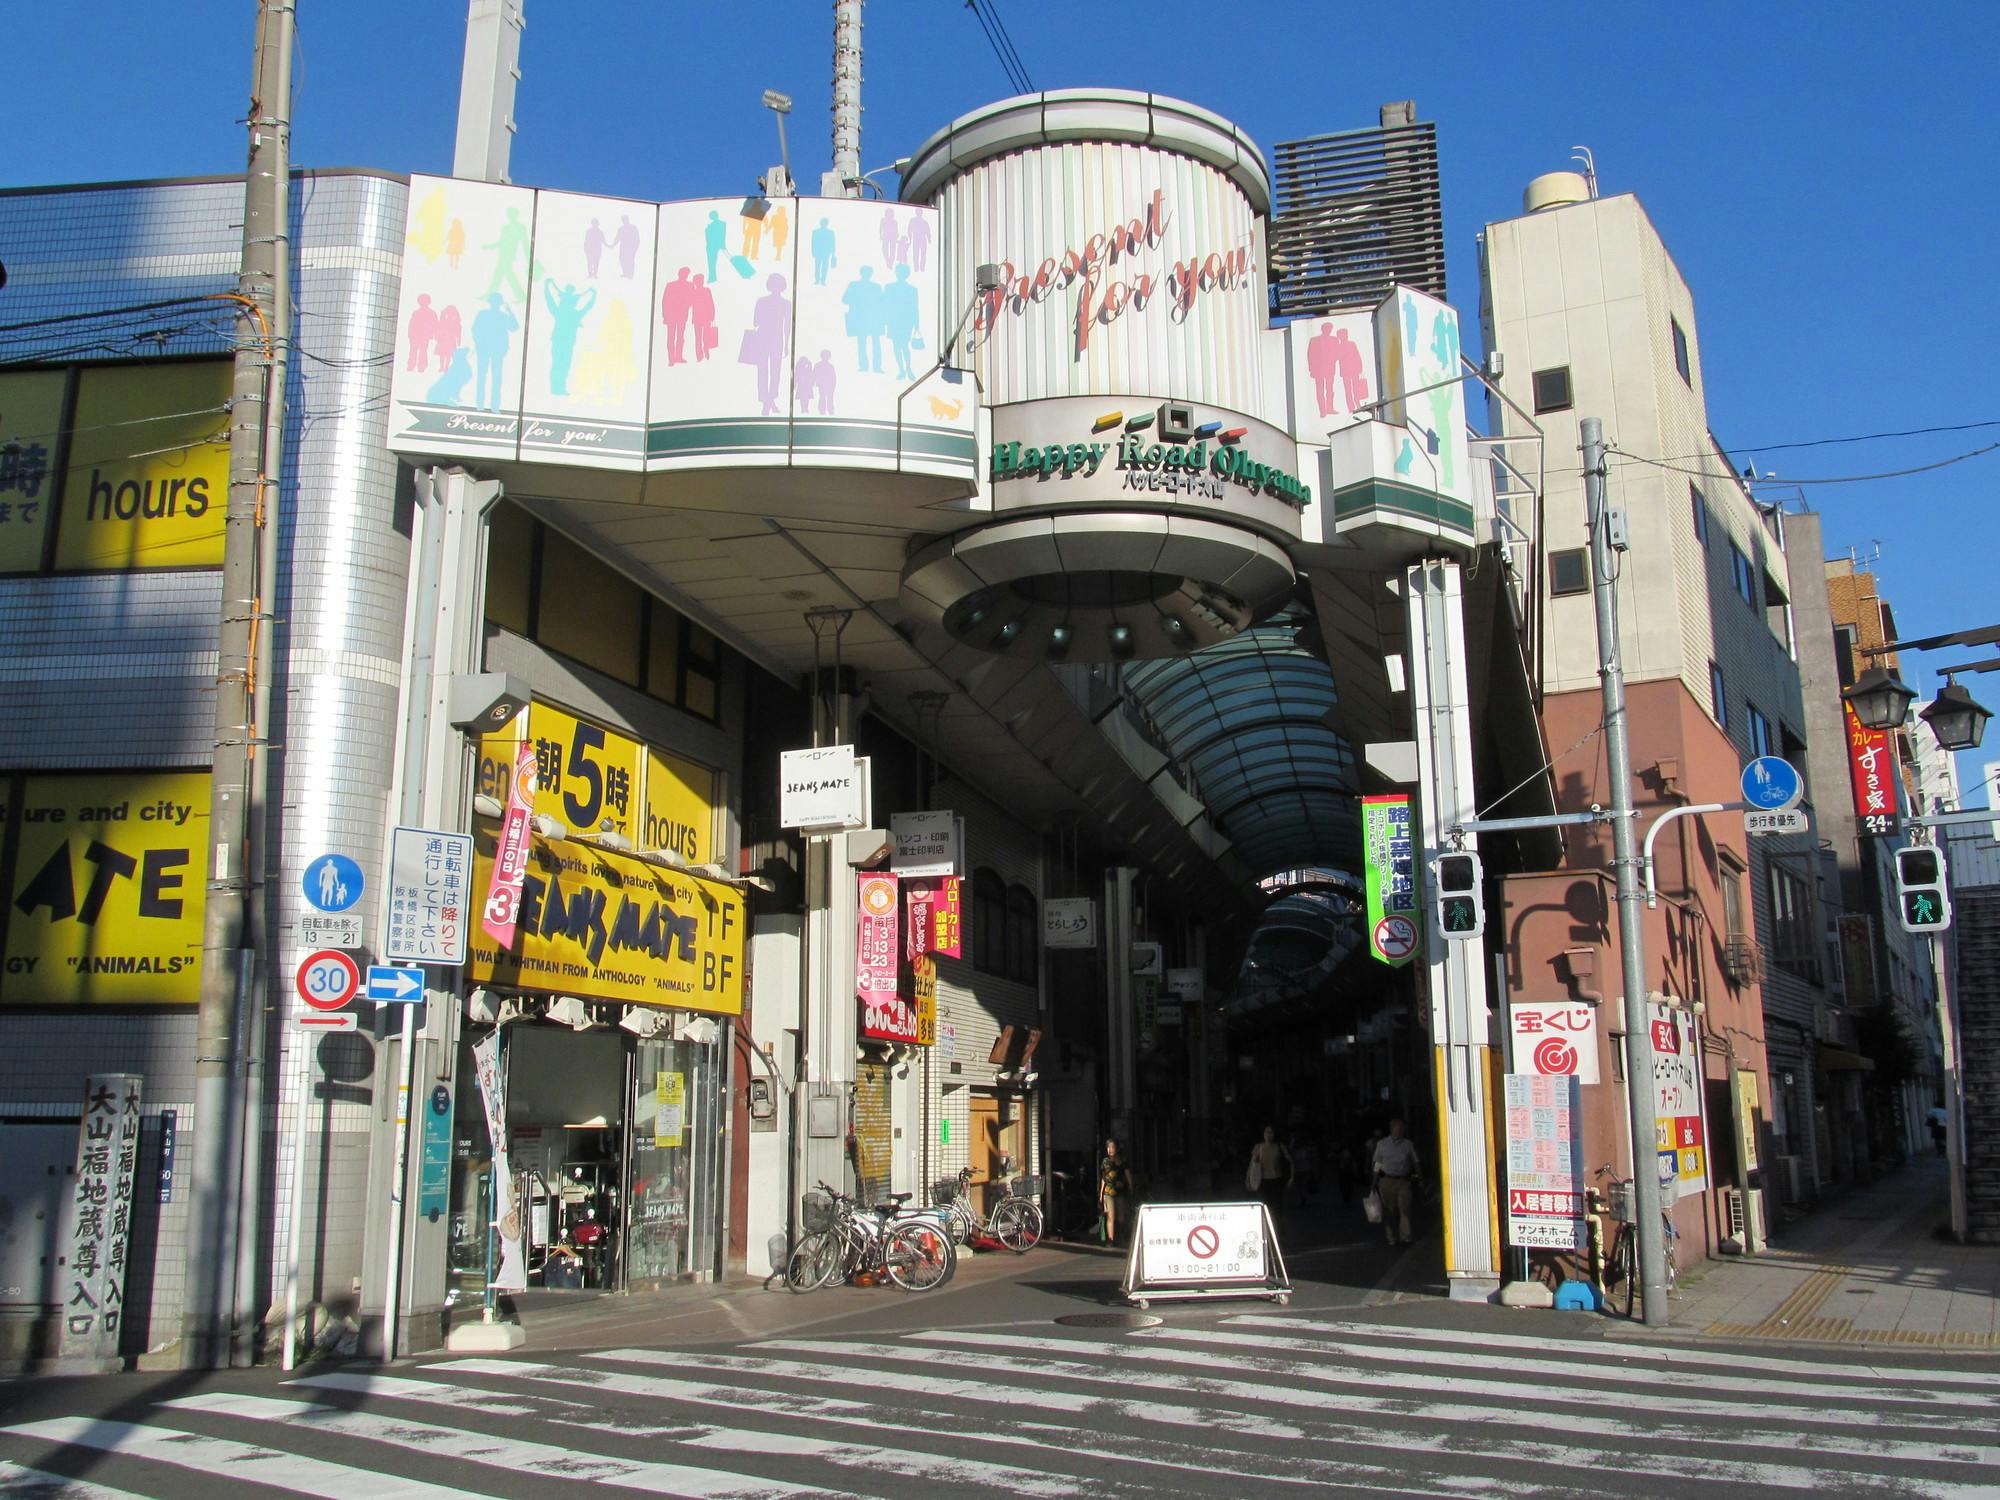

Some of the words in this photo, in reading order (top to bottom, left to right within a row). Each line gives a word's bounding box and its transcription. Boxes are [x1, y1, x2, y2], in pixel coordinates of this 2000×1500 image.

[1075, 262, 1161, 358] for
[1168, 230, 1257, 324] you!
[446, 414, 519, 434] Present
[521, 420, 554, 441] for
[561, 427, 608, 445] you!
[990, 440, 1111, 480] Happy
[1118, 432, 1207, 471] Road
[1218, 443, 1312, 505] Ohyama
[86, 469, 211, 521] hours
[1852, 731, 1884, 746] カレー
[535, 720, 630, 829] 朝5時
[786, 781, 818, 794] JEANS
[820, 778, 850, 791] MATE
[1857, 745, 1886, 814] すき家
[79, 802, 129, 821] and
[140, 801, 192, 826] city
[646, 801, 698, 860] hours
[1749, 814, 1796, 828] 歩行者優先
[418, 837, 443, 955] 通行して下さい
[440, 841, 464, 957] 自転車は降りて
[623, 874, 654, 891] nature
[676, 887, 694, 904] city
[302, 917, 360, 931] 自転車を除く
[403, 886, 420, 953] 板橋区役所
[935, 910, 948, 950] 加盟店
[947, 879, 960, 948] ハローカード
[305, 931, 317, 943] 13
[342, 932, 355, 945] 21
[311, 966, 345, 993] 30
[475, 948, 506, 965] WALT
[509, 953, 560, 974] WHITMAN
[562, 964, 589, 979] FROM
[592, 968, 647, 986] ANTHOLOGY
[703, 950, 734, 994] BF
[1515, 1009, 1591, 1034] 宝くじ
[1661, 1086, 1683, 1111] オープン
[67, 1084, 118, 1336] 大山福地蔵尊入口
[104, 1084, 140, 1334] 大山福地蔵尊入口
[1512, 1192, 1583, 1213] 入居者募集
[1517, 1224, 1579, 1237] サンキホーム
